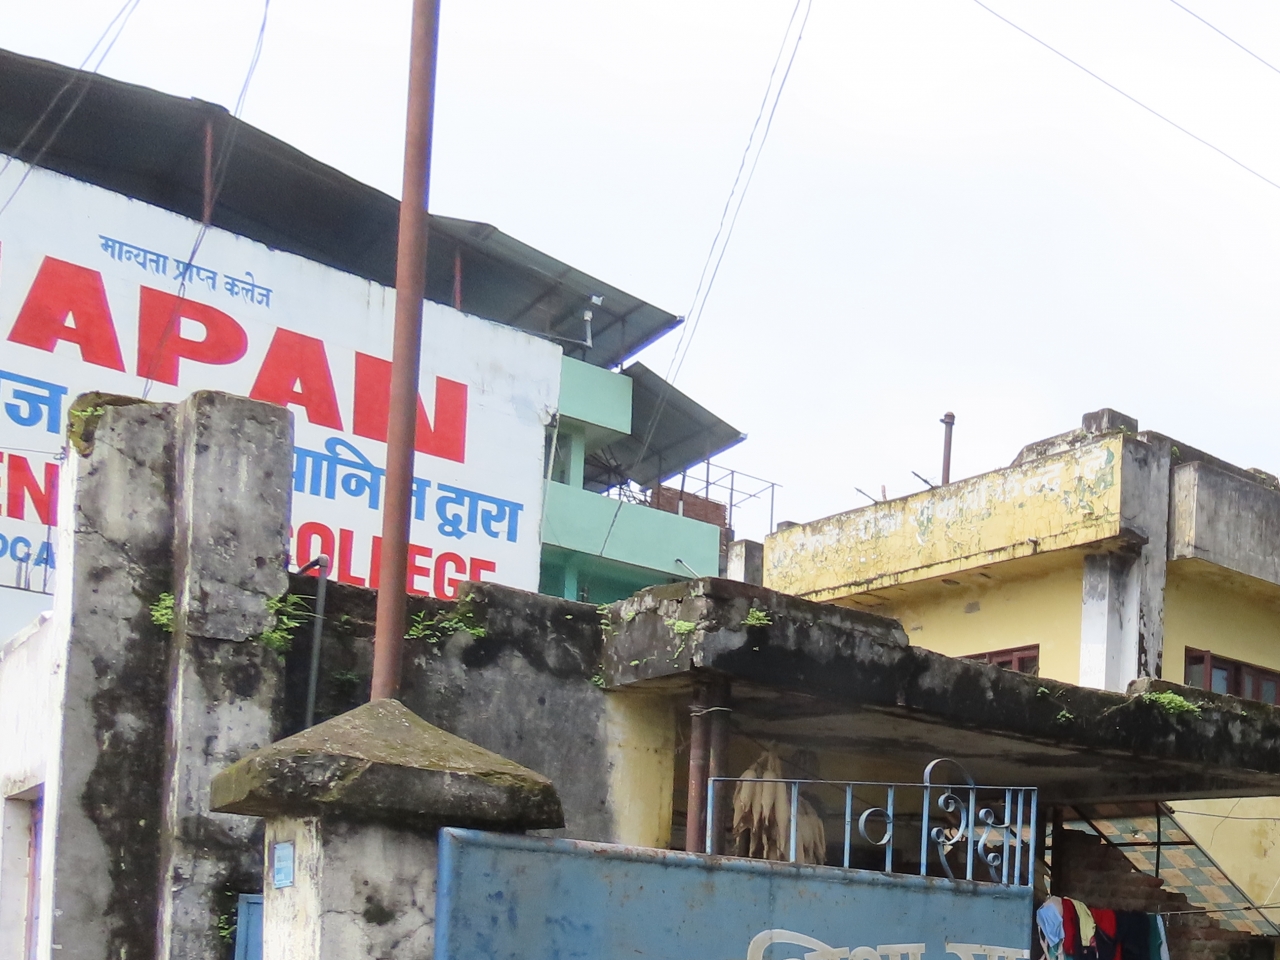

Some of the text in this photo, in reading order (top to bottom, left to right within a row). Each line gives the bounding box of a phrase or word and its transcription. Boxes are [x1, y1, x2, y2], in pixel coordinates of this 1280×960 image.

[98, 234, 273, 309] मान्यता प्राप्त कलेज
[0, 241, 468, 464] APAN
[435, 483, 524, 543] द्वारा
